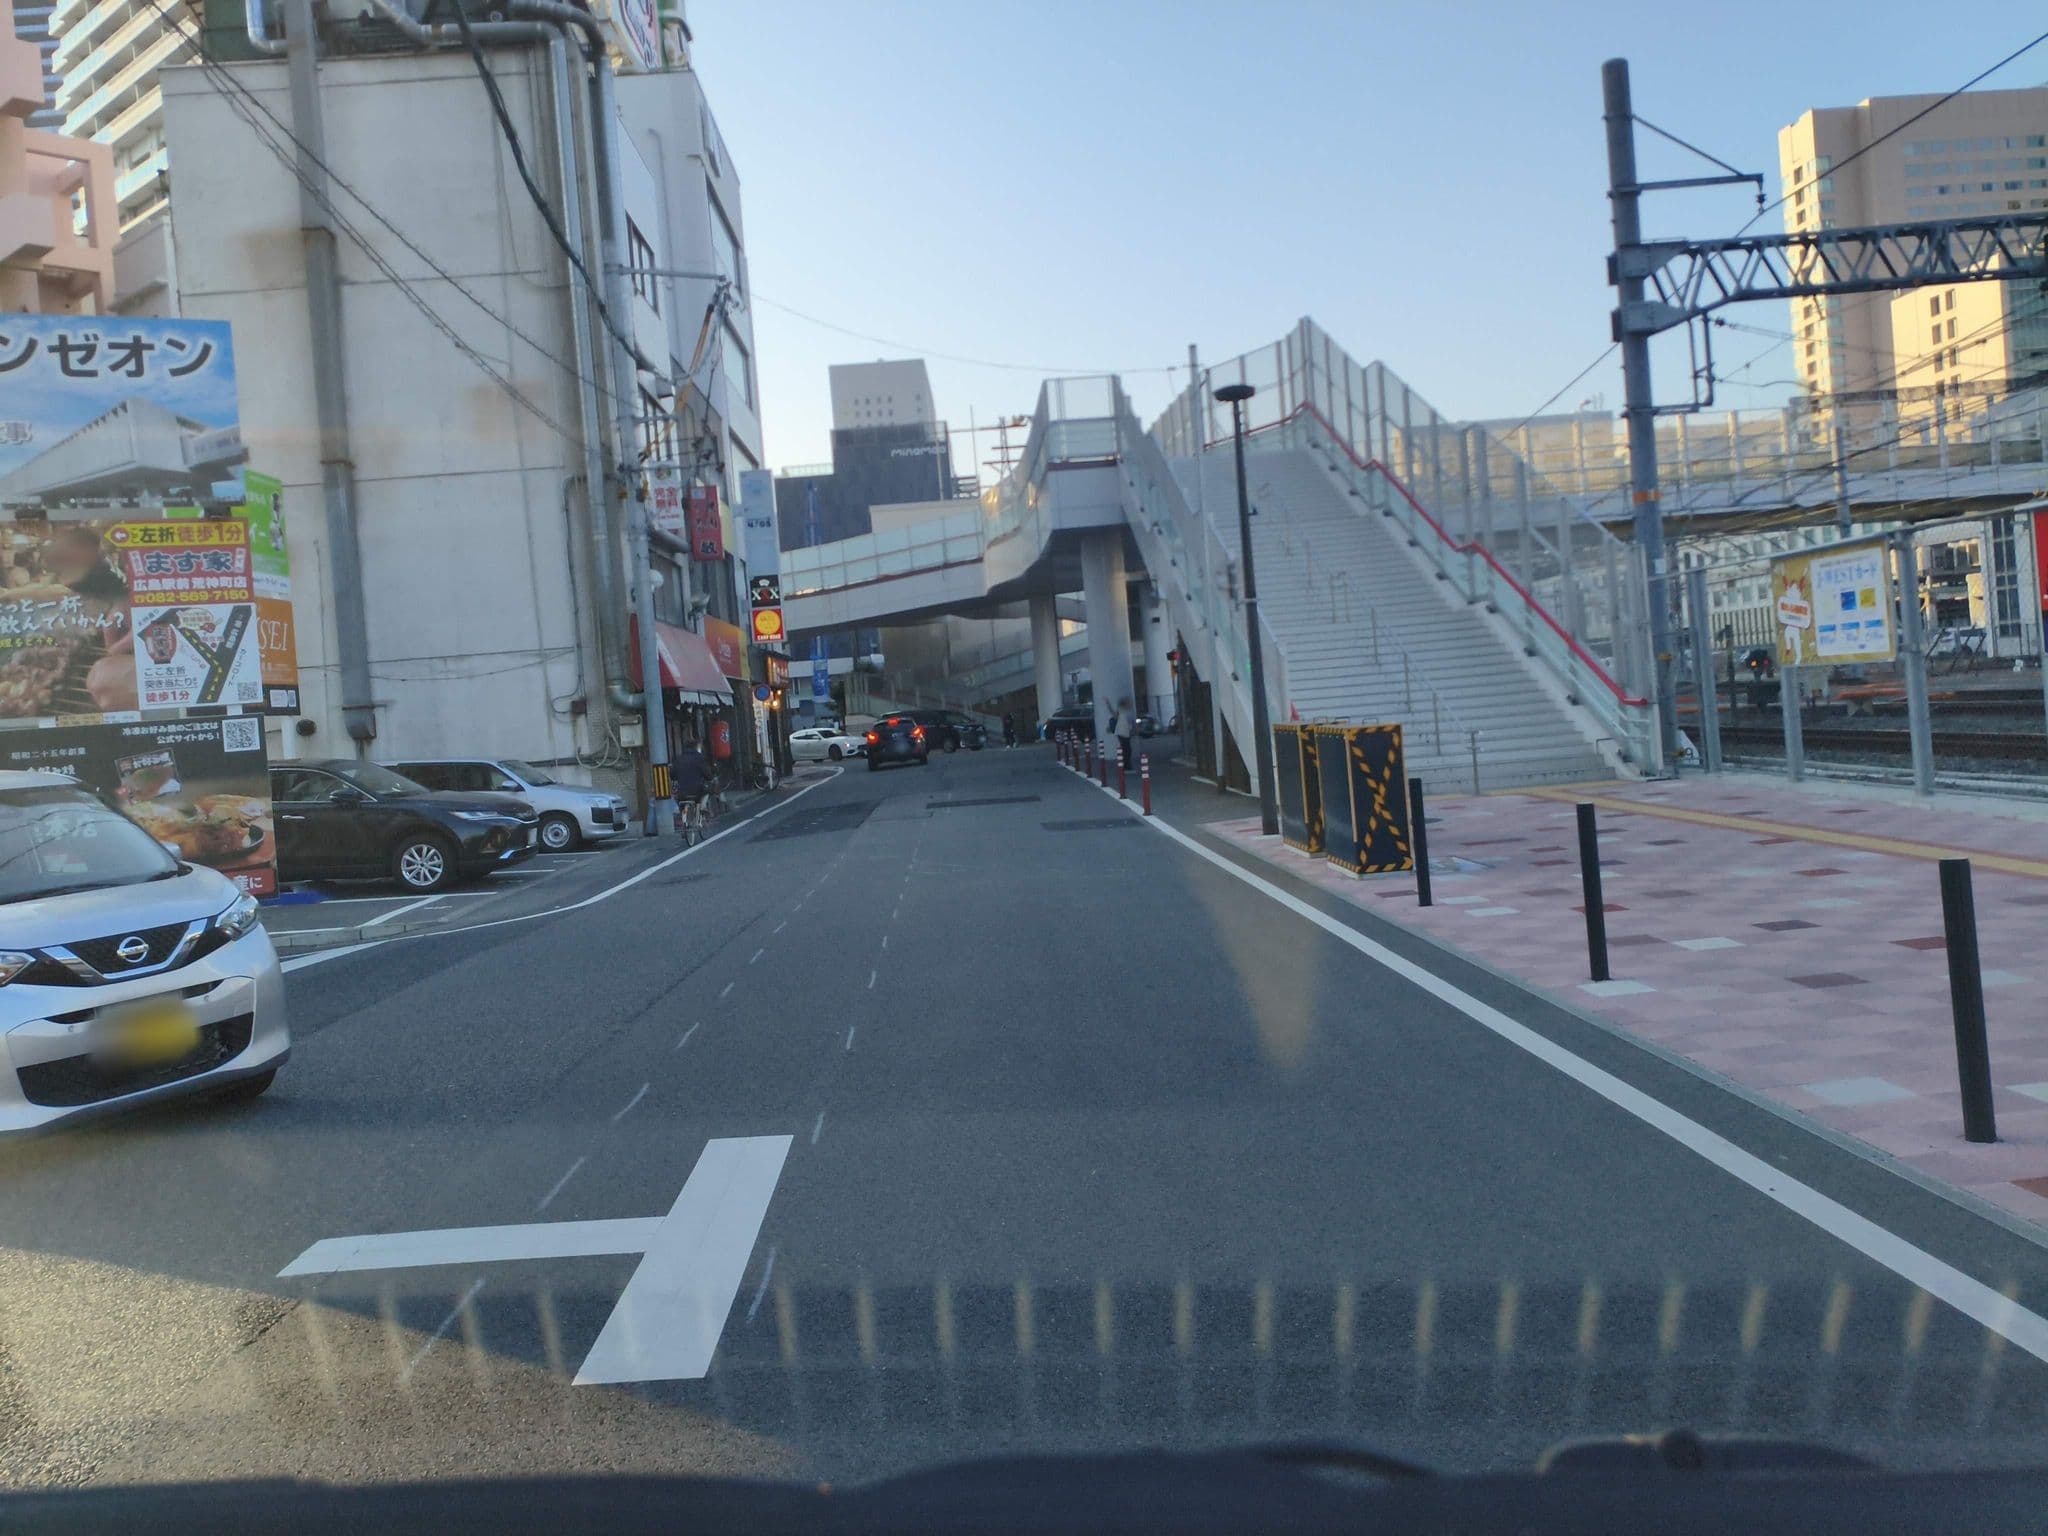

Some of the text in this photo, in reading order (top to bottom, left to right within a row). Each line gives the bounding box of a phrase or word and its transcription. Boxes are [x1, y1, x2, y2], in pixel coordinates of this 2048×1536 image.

[144, 549, 234, 575] ます家
[146, 690, 190, 703] 徒歩1分
